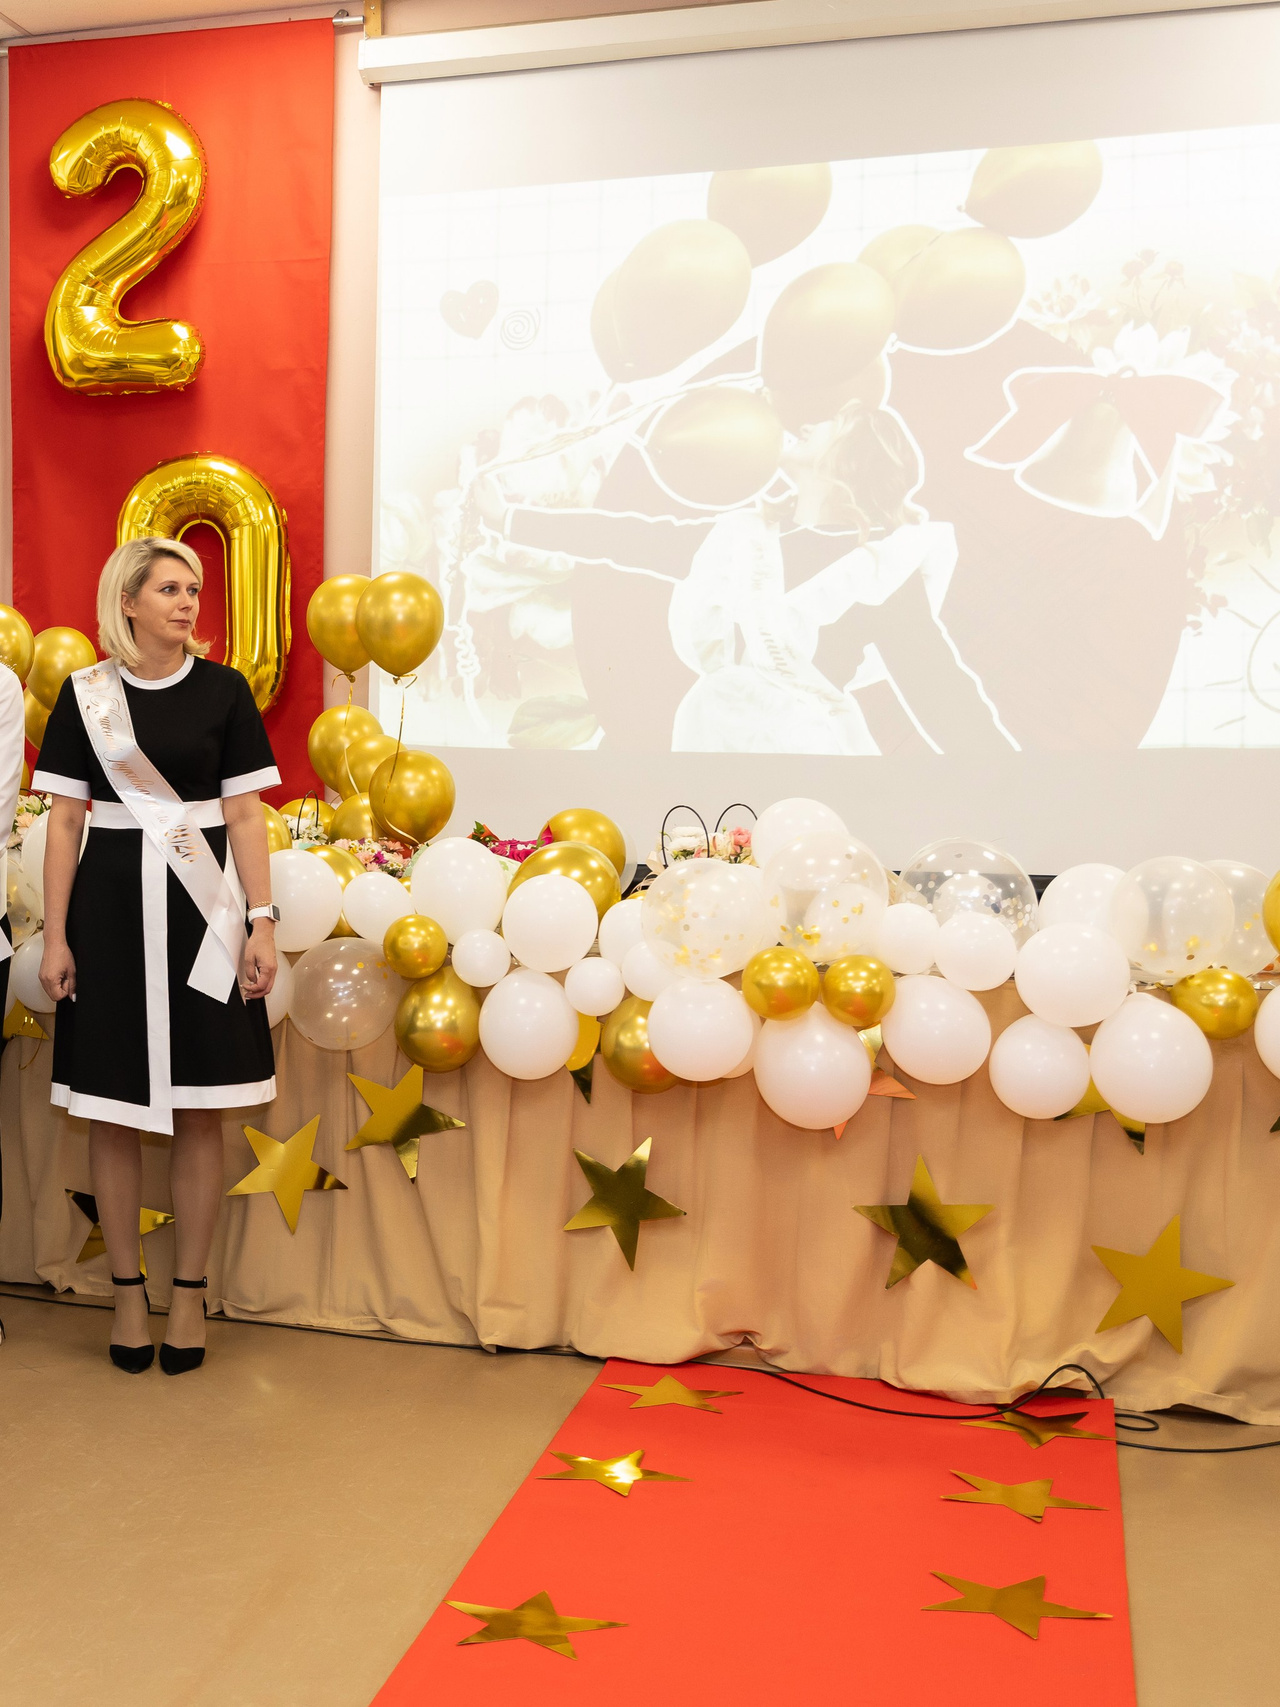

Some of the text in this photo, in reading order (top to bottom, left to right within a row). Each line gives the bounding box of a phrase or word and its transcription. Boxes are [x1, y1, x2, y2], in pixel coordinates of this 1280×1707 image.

[44, 98, 208, 396] 2
[117, 452, 292, 714] 0
[164, 823, 207, 863] 2026
